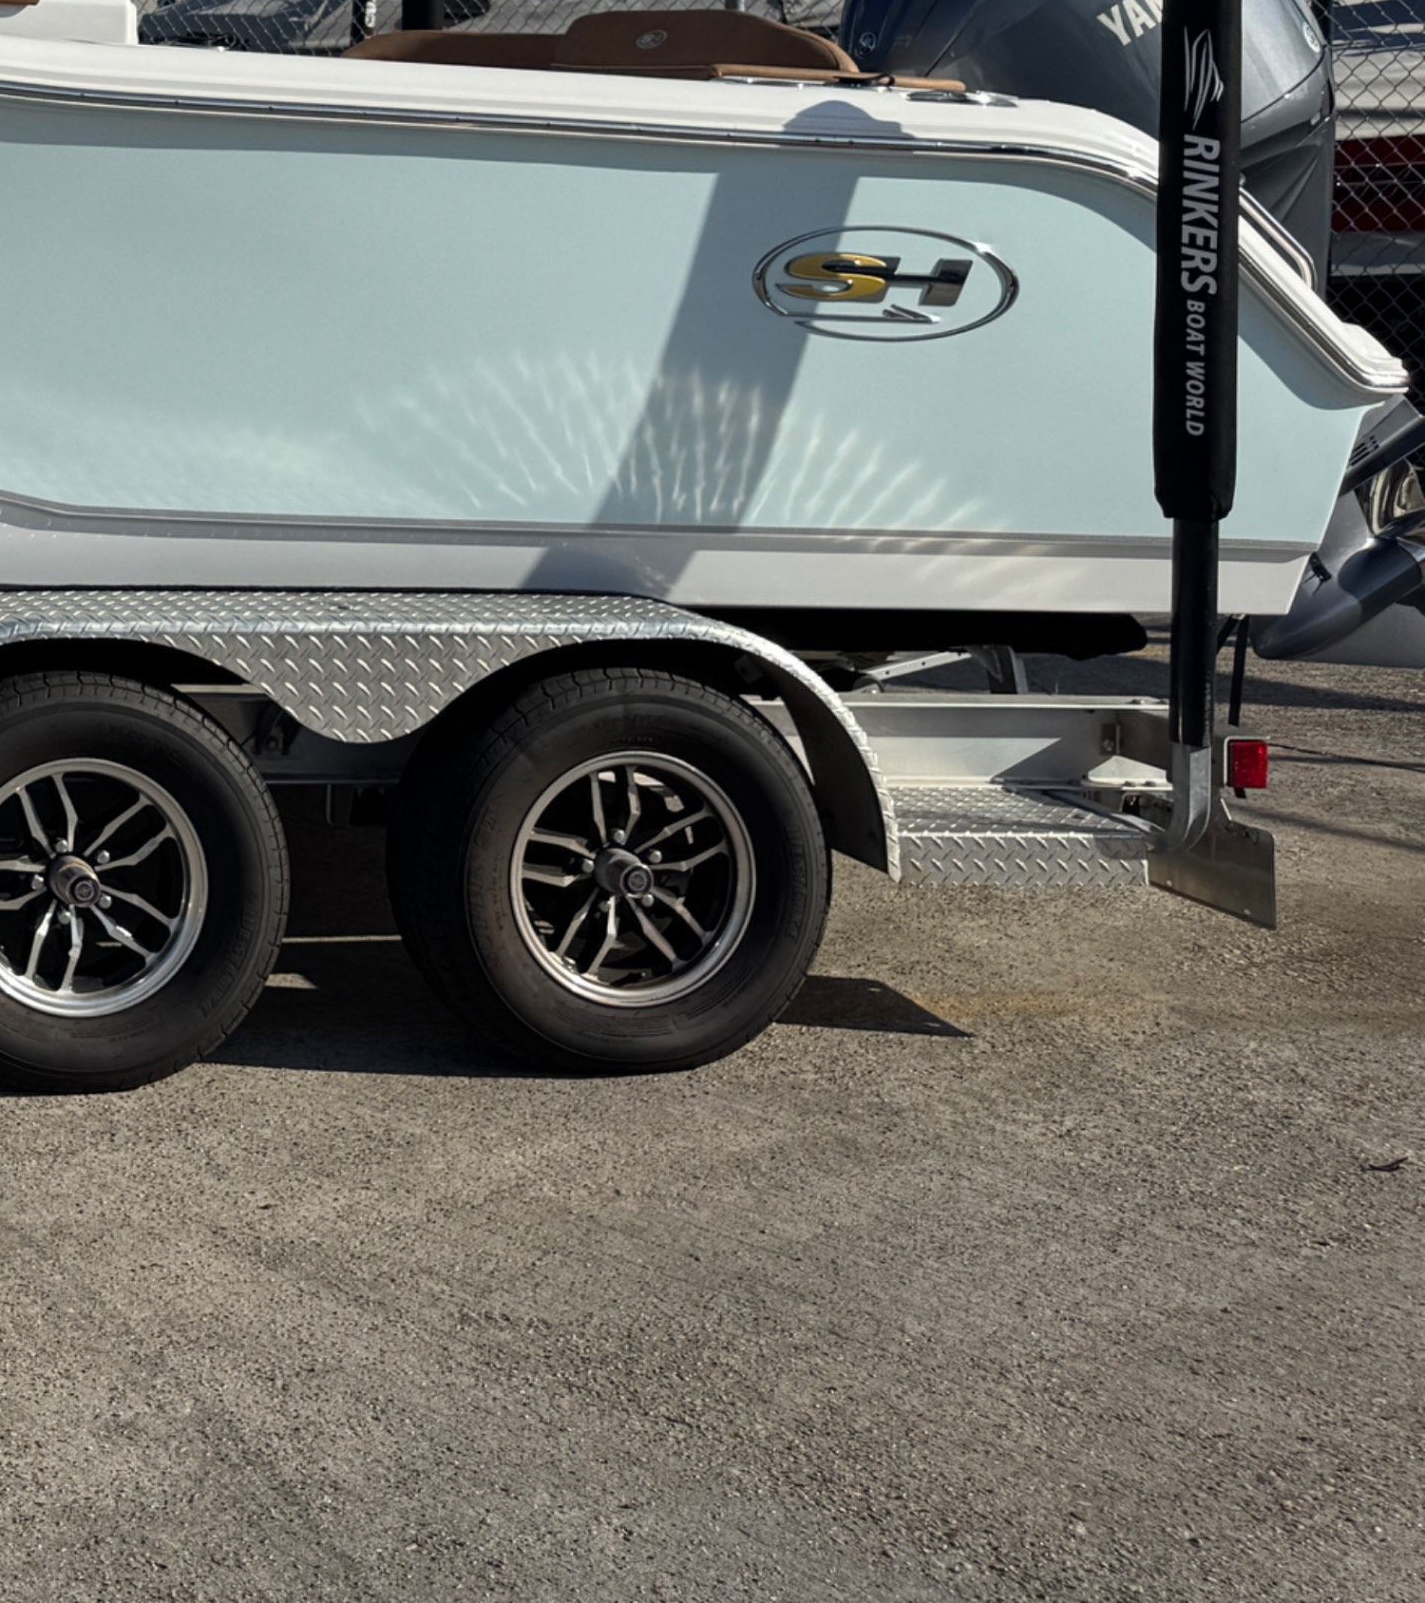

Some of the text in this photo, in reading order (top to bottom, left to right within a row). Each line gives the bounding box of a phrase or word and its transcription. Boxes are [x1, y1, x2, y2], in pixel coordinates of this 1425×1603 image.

[1181, 133, 1221, 437] RINKERS BOAT WORLD
